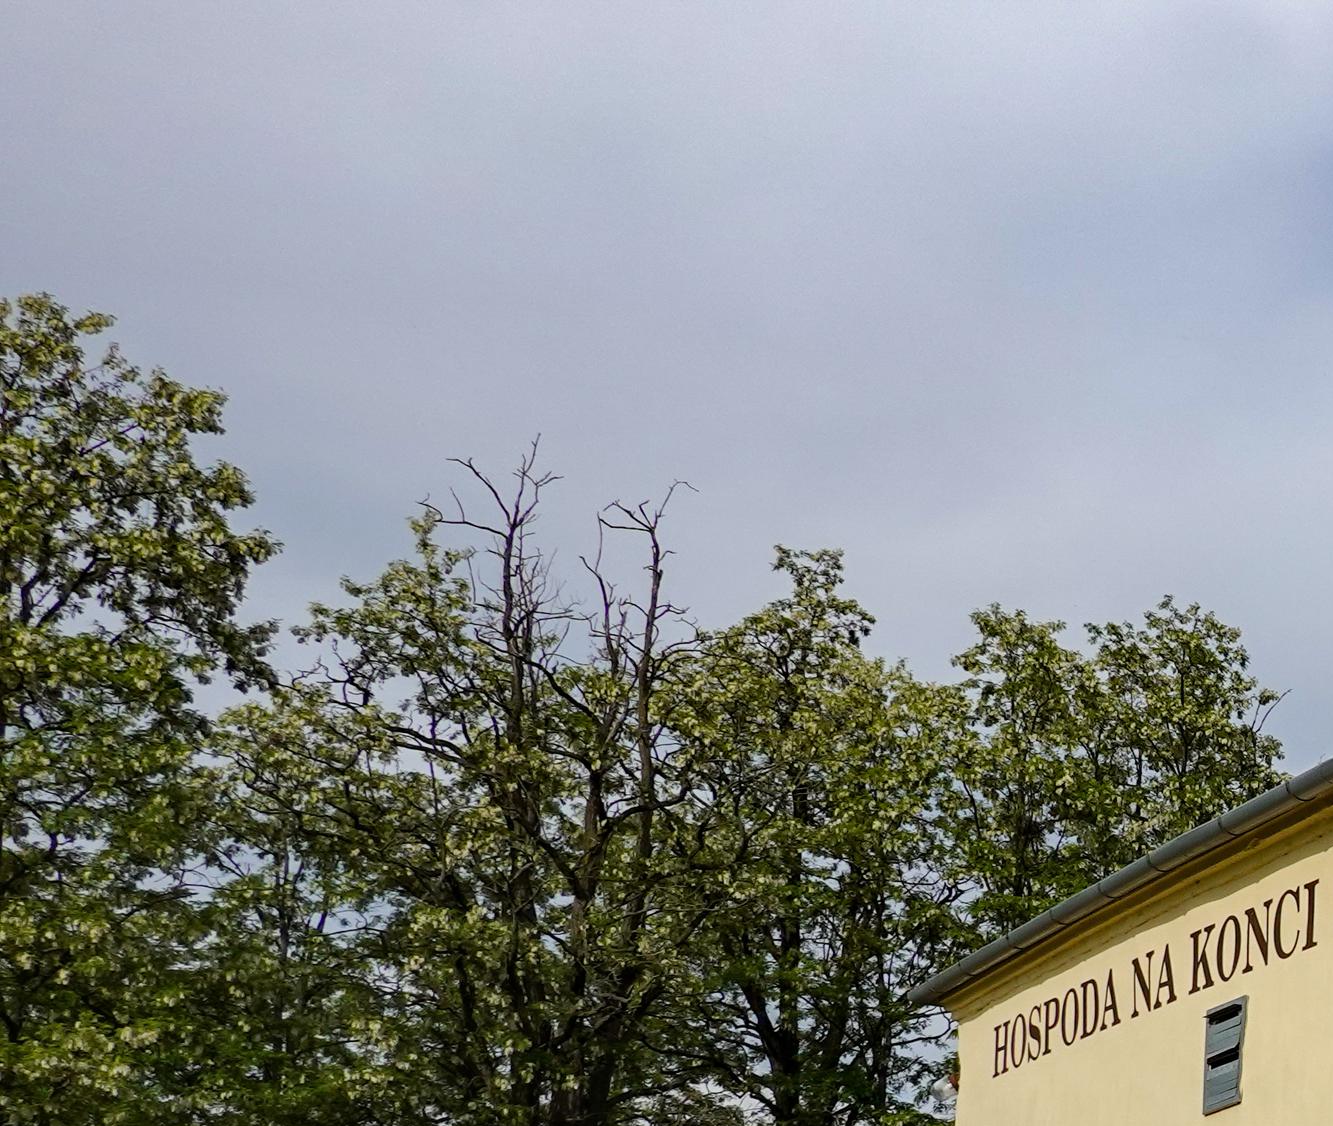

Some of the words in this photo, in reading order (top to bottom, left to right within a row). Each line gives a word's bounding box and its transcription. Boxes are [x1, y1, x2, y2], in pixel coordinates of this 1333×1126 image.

[992, 968, 1121, 1079] HOSPODA
[1130, 943, 1177, 1019] NA
[1188, 878, 1320, 996] KONCI
